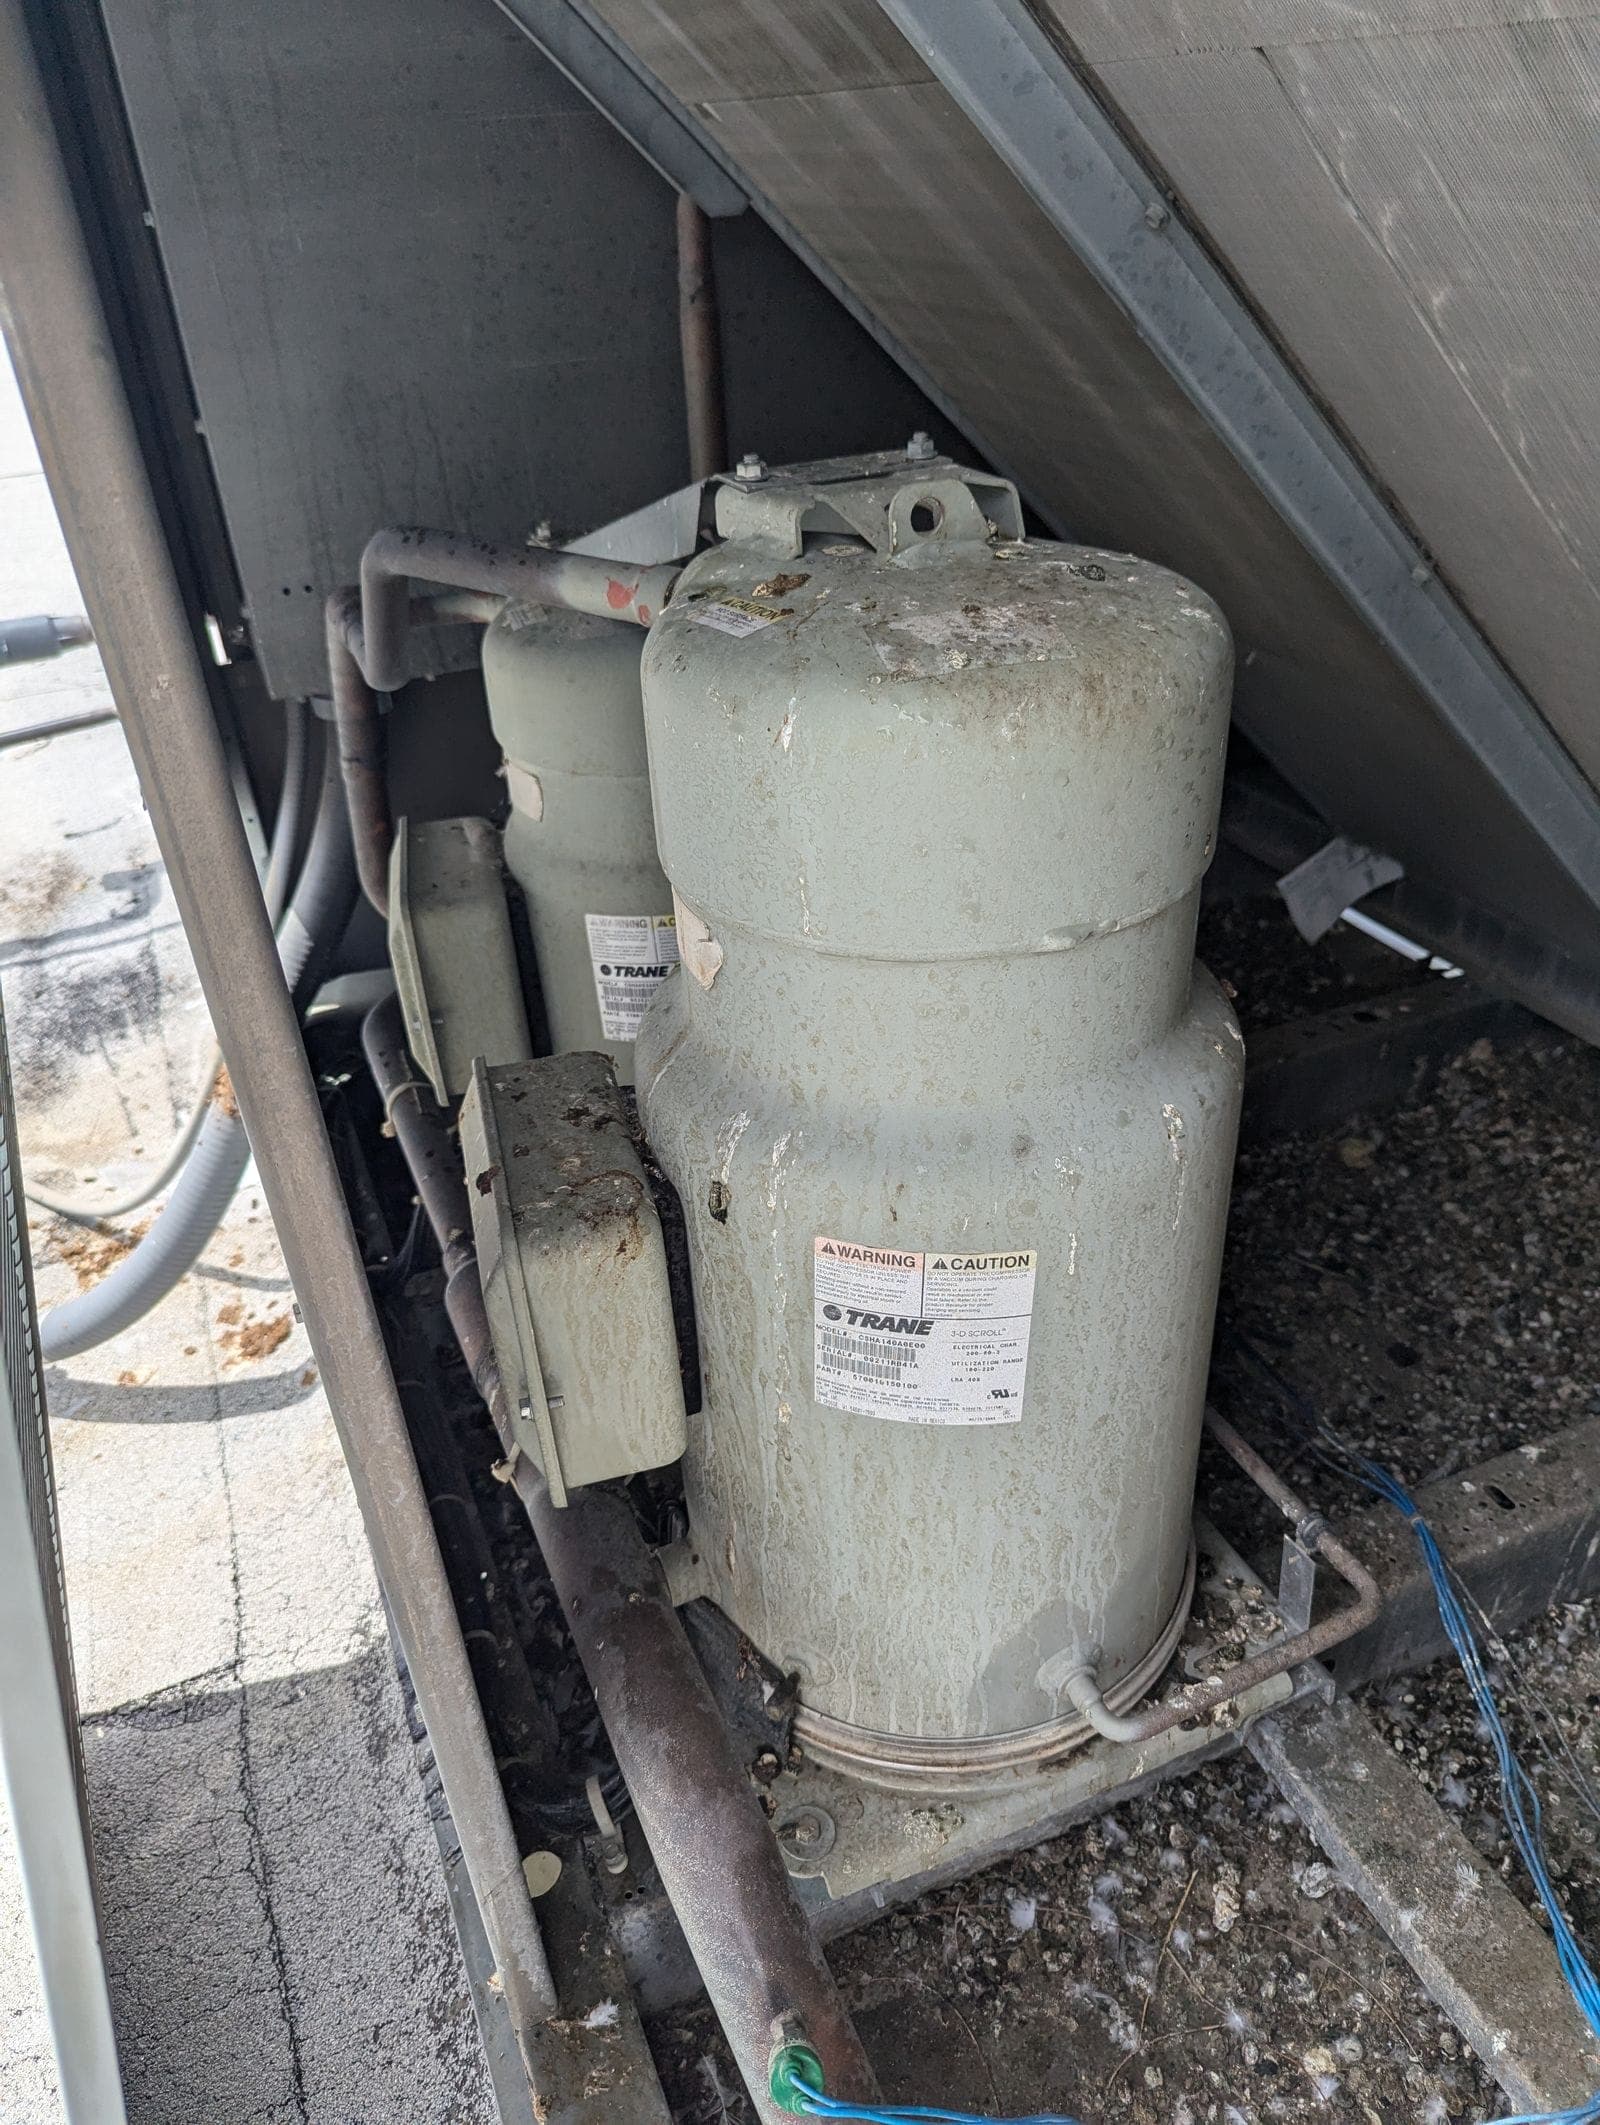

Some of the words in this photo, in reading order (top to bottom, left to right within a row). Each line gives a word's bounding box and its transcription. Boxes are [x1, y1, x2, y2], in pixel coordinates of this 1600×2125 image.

[732, 599, 780, 620] CAUTION
[614, 965, 669, 978] TRANE
[837, 1244, 916, 1268] WARNING
[951, 1254, 1029, 1270] CAUTION
[846, 1309, 935, 1335] TRANE
[1003, 1357, 1024, 1365] RANGE
